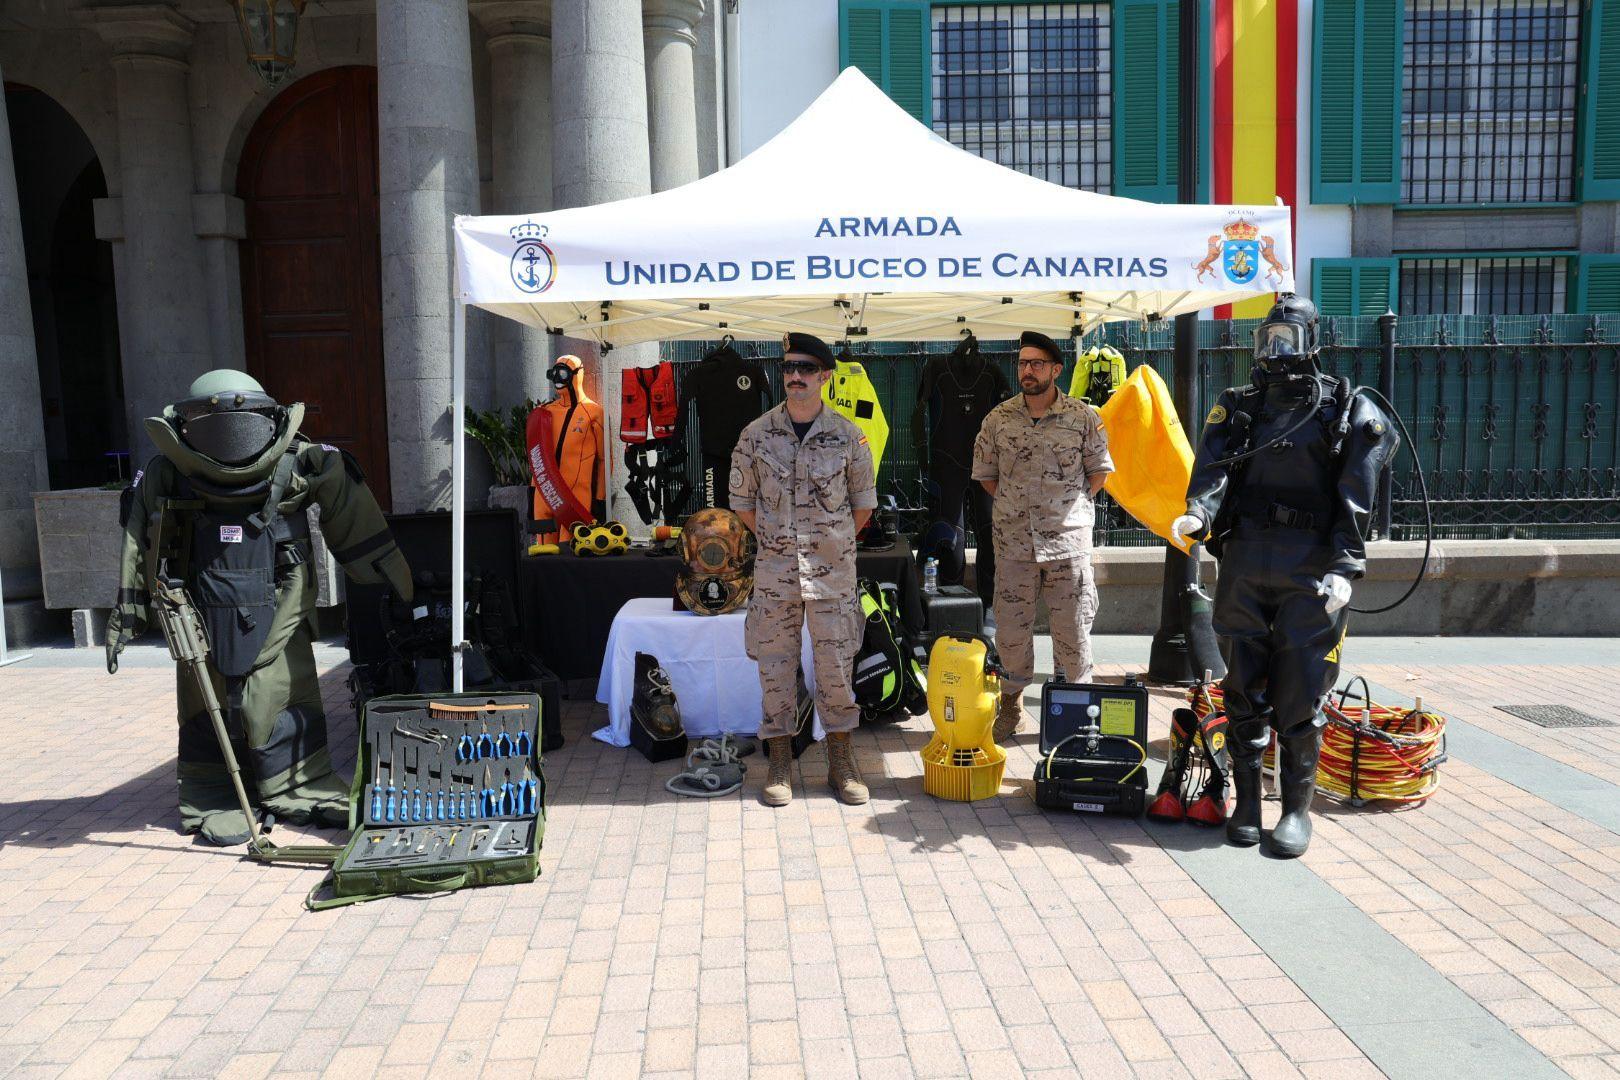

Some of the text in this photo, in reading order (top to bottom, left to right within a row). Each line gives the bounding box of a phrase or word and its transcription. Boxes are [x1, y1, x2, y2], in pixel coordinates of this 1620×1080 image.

[814, 216, 962, 238] ARMADA
[604, 252, 1168, 286] UNIDAD DE BUCEO DE CANARIAS
[540, 480, 563, 510] RESCATE
[705, 467, 715, 508] ARMADA
